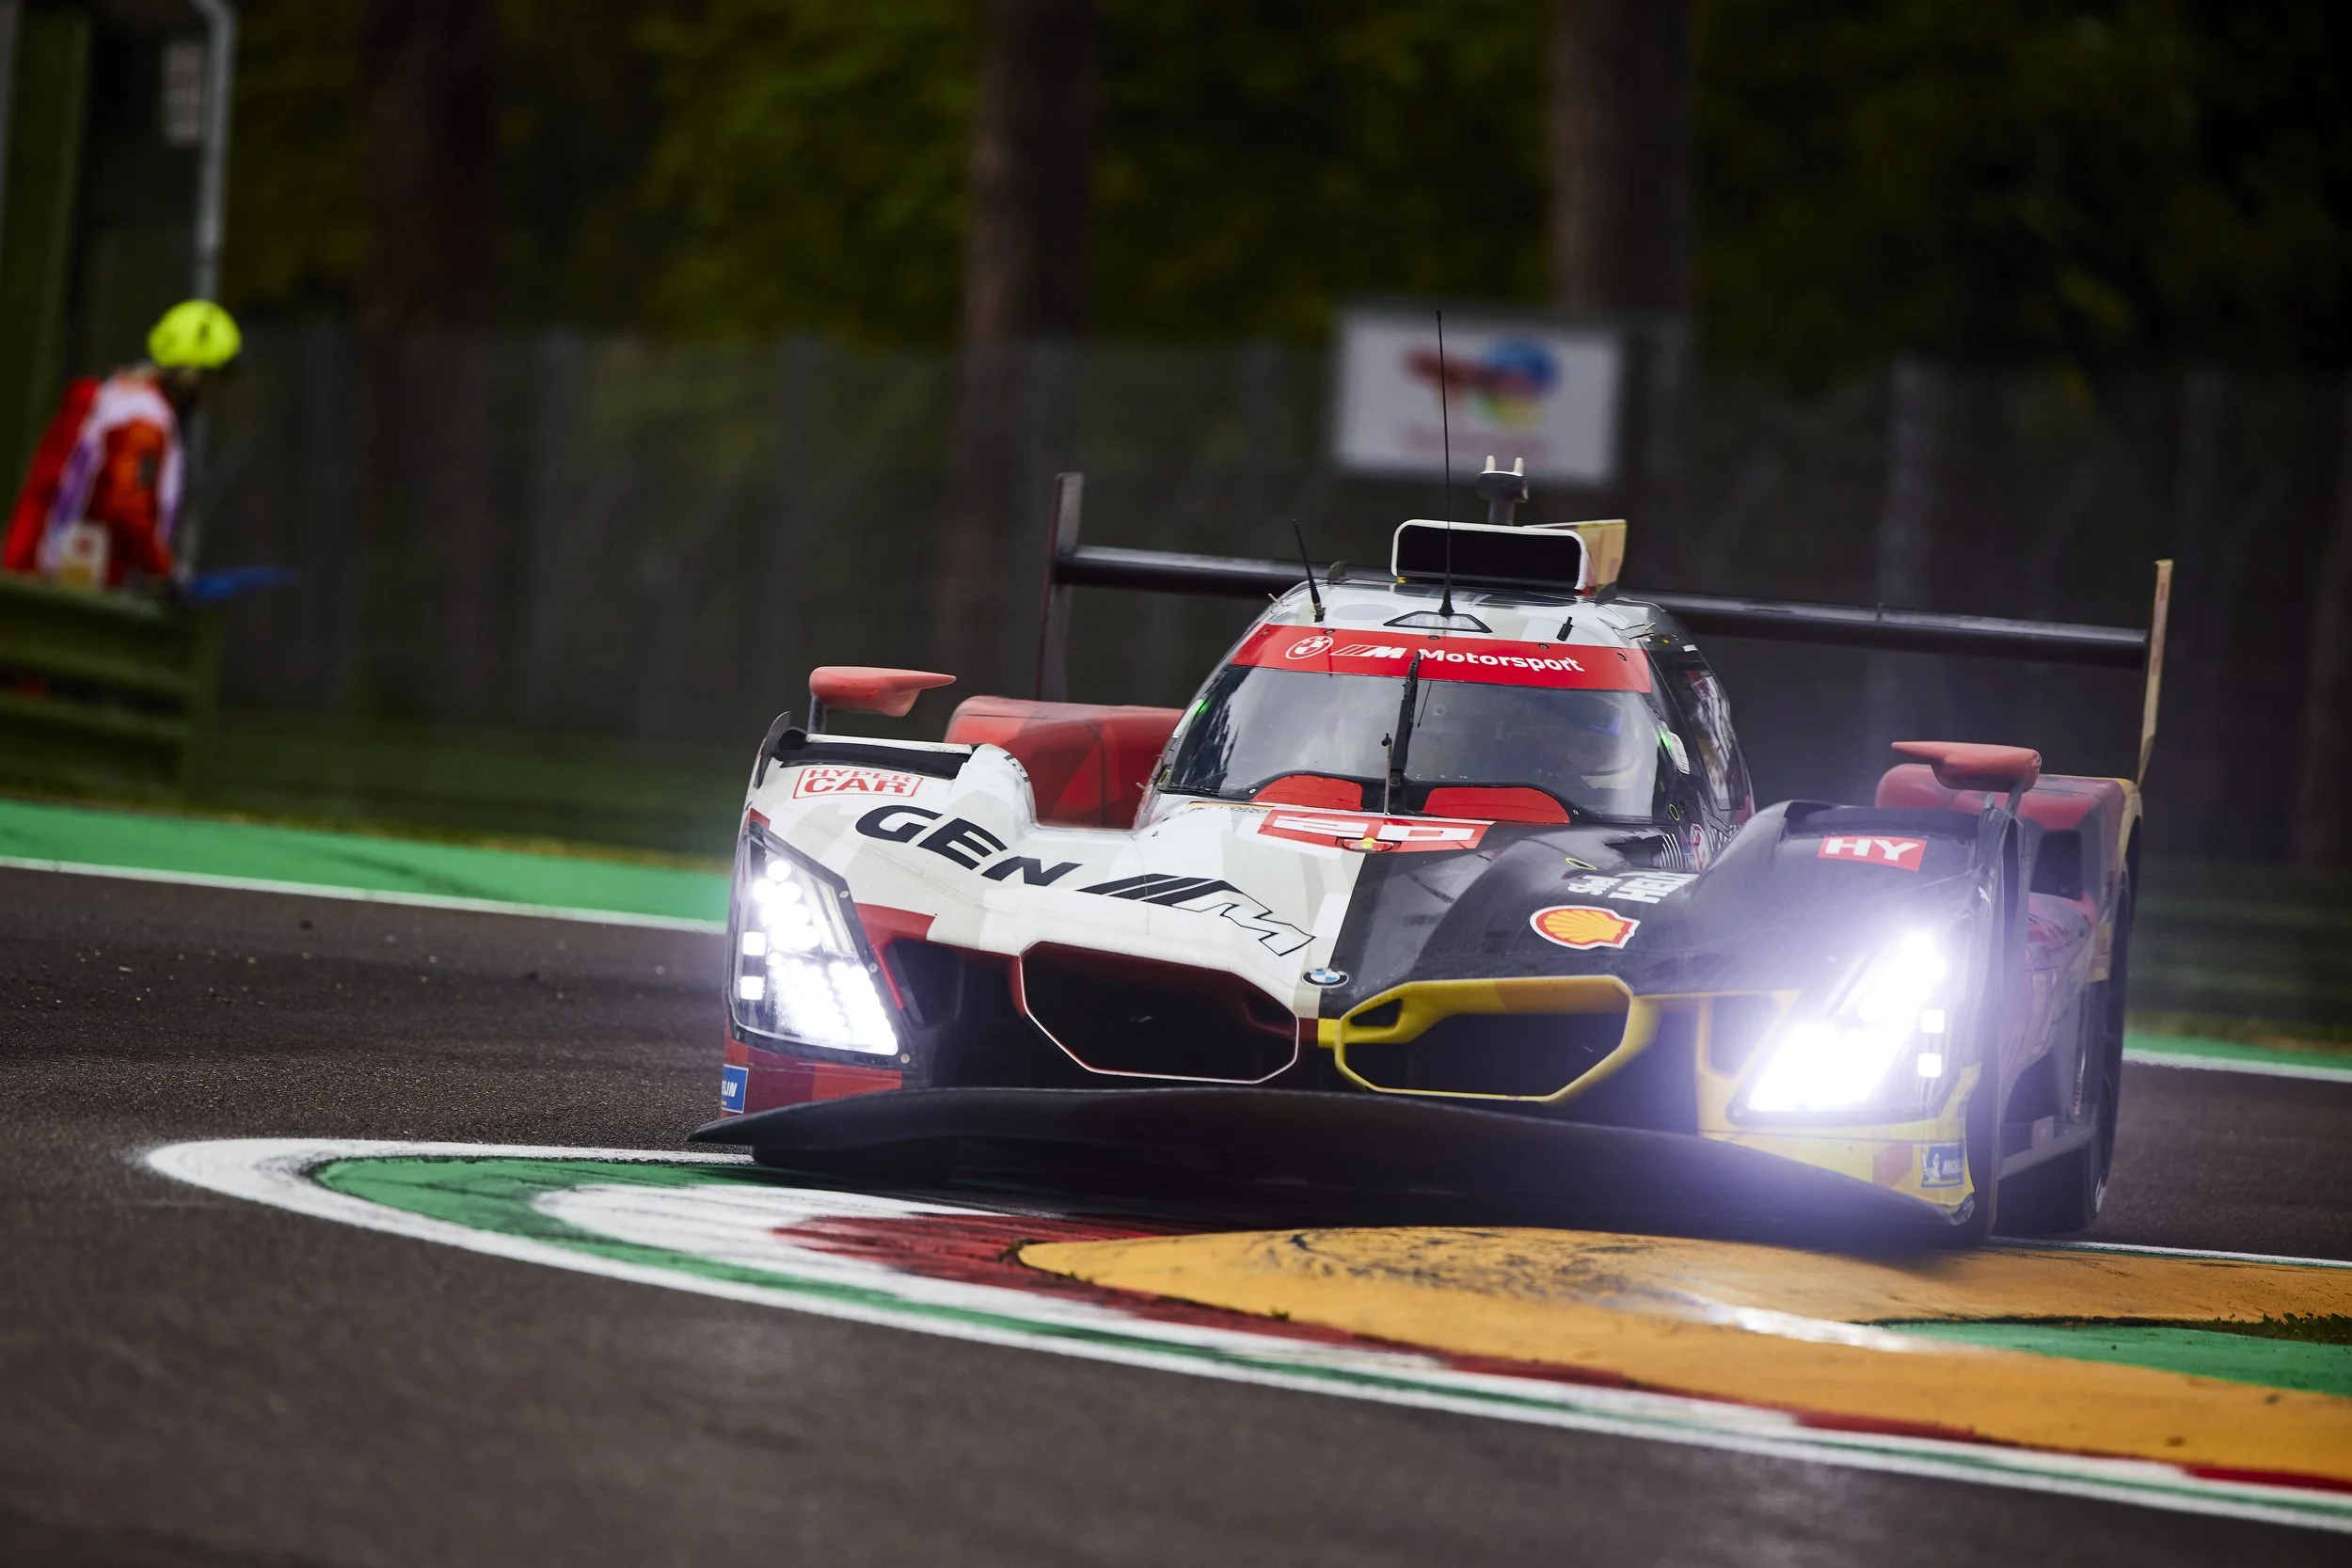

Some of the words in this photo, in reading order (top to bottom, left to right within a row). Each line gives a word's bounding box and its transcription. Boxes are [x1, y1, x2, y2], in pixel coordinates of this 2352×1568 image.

[1419, 649, 1585, 672] Motorsport
[803, 777, 908, 794] CAR
[808, 768, 912, 783] HYPER
[855, 804, 1084, 887] GEN
[1825, 838, 1920, 862] HY
[1567, 875, 1622, 895] Shell
